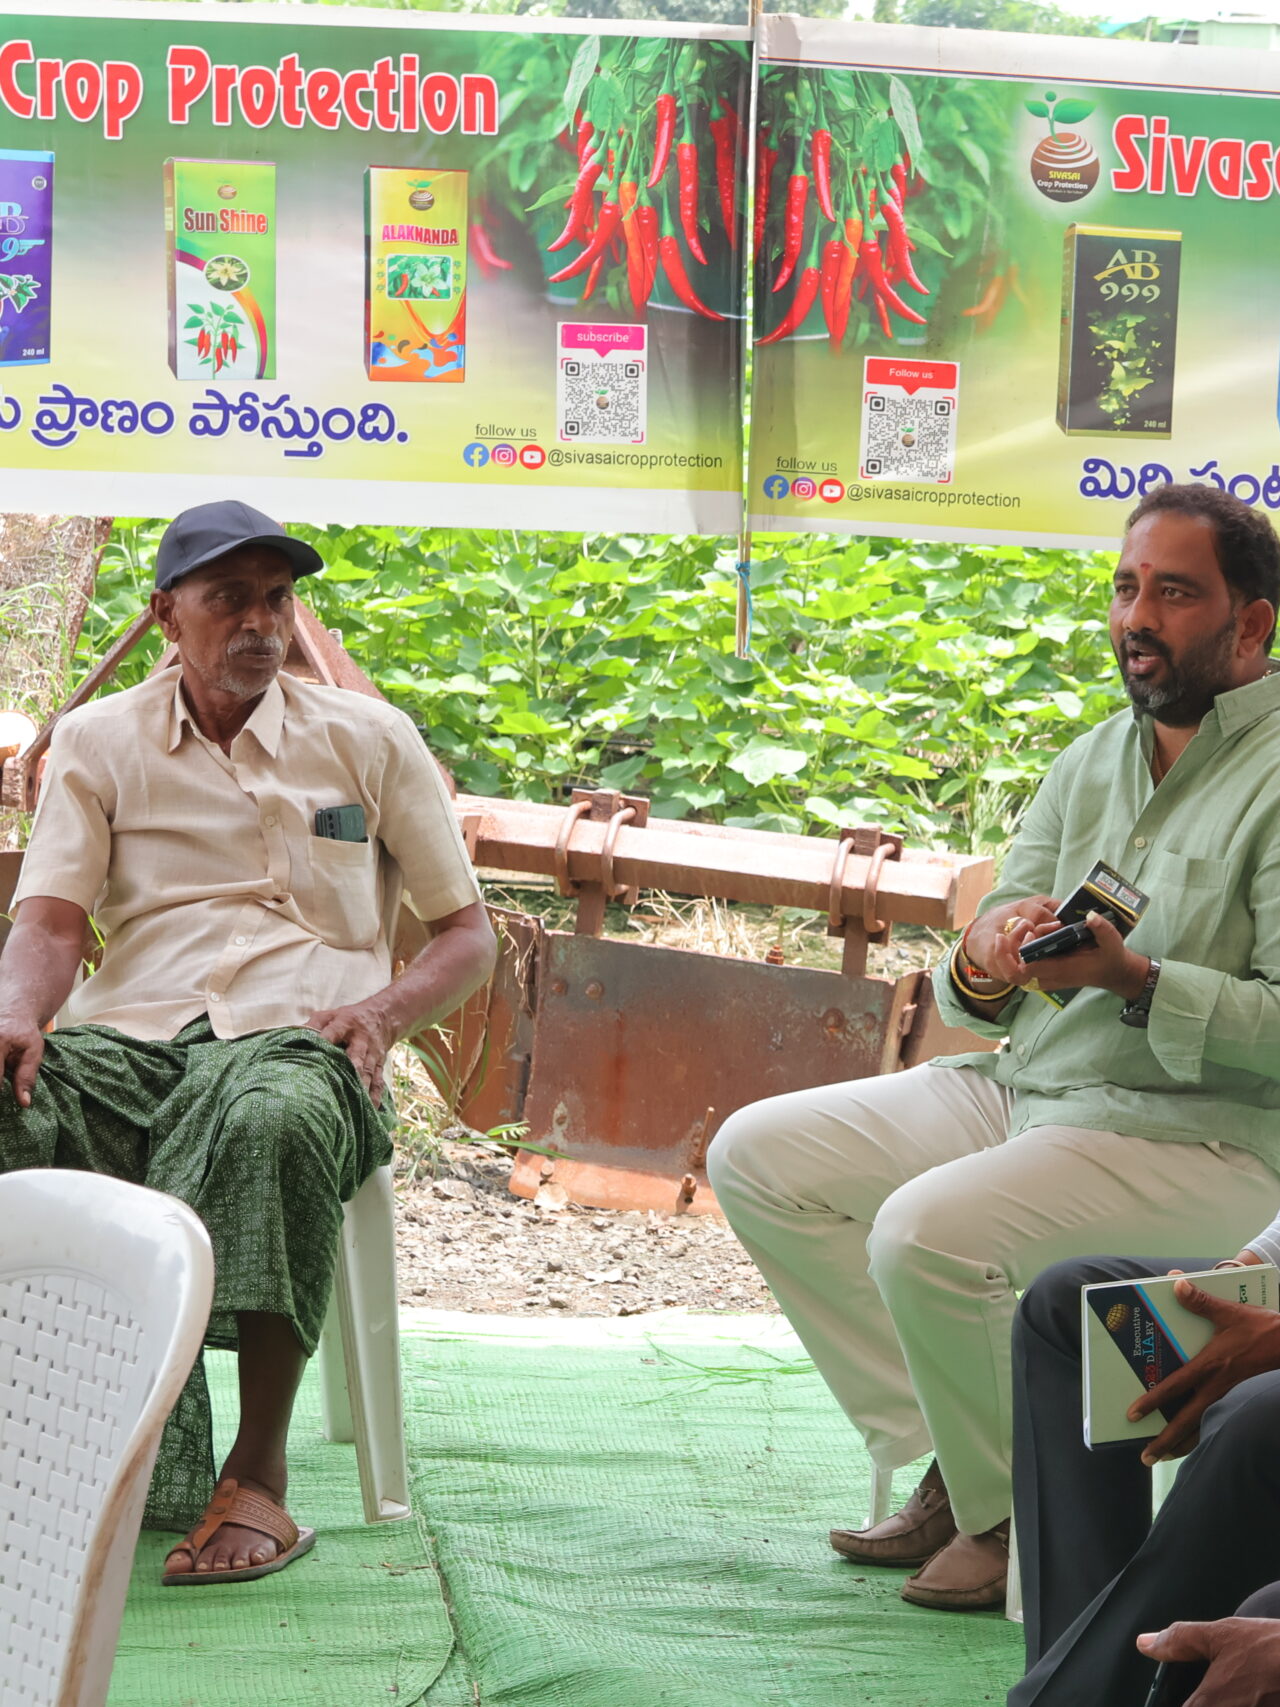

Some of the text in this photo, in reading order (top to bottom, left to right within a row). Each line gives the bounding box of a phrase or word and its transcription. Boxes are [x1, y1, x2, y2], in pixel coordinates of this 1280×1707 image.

[0, 39, 499, 140] Crop Protection
[1037, 180, 1088, 190] Crop Protection
[1048, 170, 1081, 180] SIVASAI
[184, 206, 268, 234] Sun Shine
[382, 224, 459, 246] ALAKNANDA
[1093, 249, 1163, 281] AB
[1100, 282, 1160, 303] 999
[576, 331, 630, 343] subscribe
[22, 347, 45, 356] 240 ml
[889, 367, 934, 379] Follow us
[31, 383, 175, 448] ప్రాణం
[188, 388, 409, 458] పోస్తుంది.
[475, 424, 537, 438] follow us
[548, 449, 723, 469] @sivasaicropprotection
[776, 456, 838, 472] follow us
[847, 484, 1021, 508] @sivasaicropprotection
[1133, 1307, 1142, 1356] Executive
[1142, 1320, 1155, 1364] DIARY
